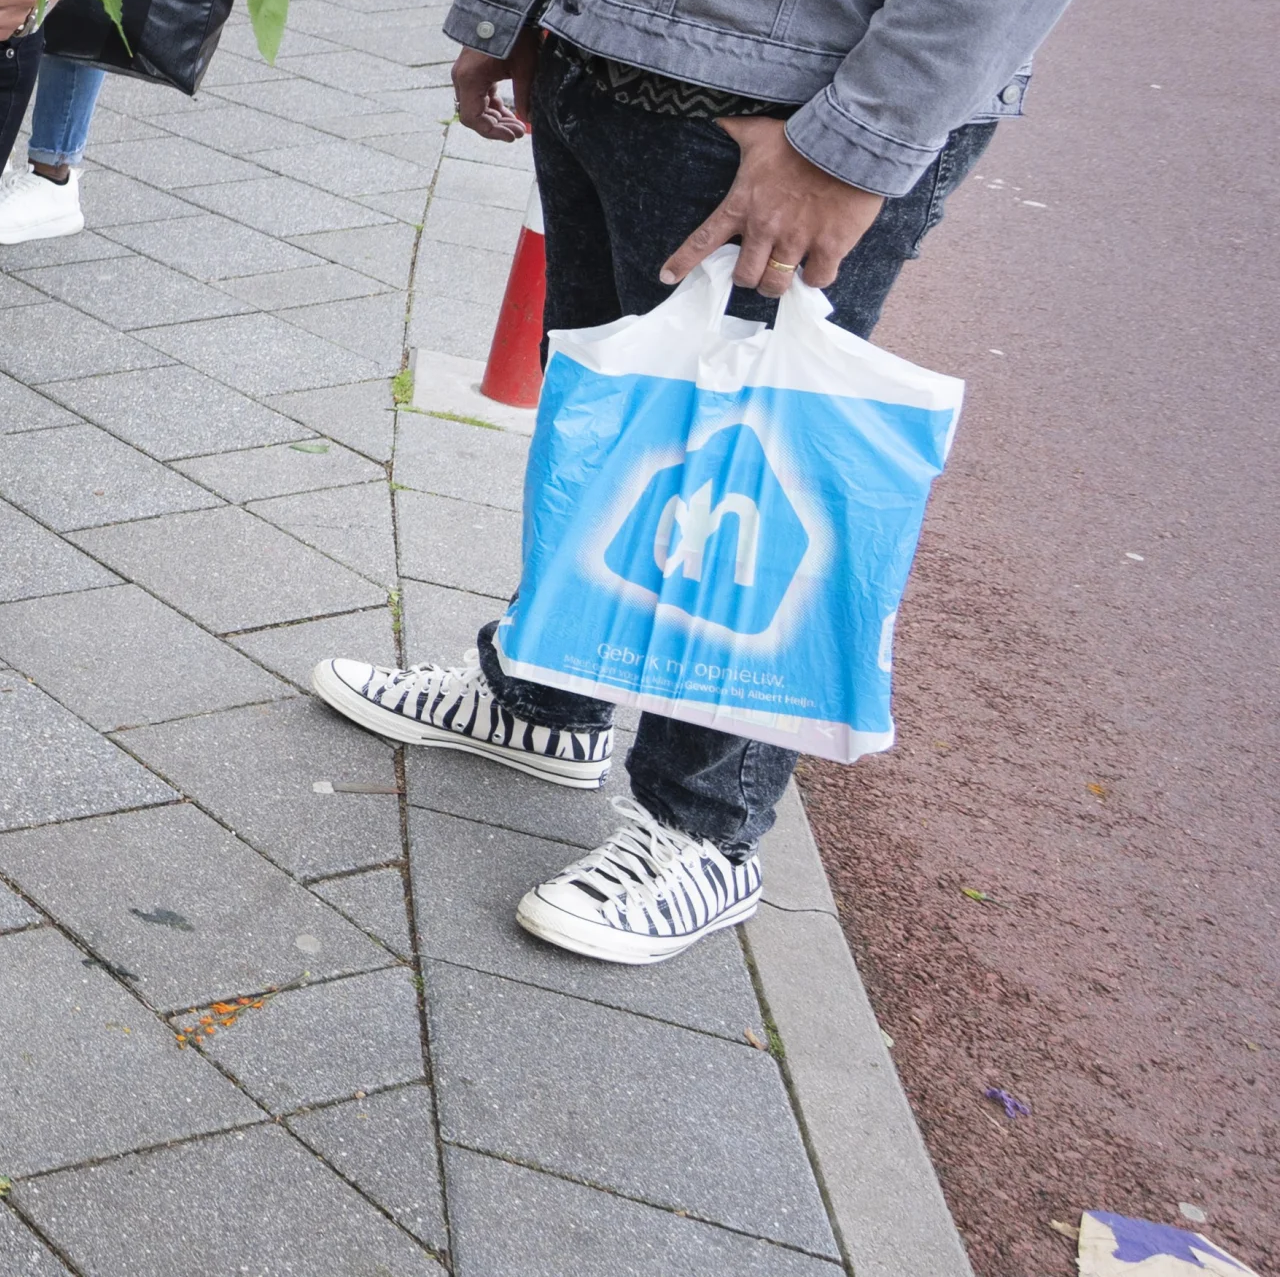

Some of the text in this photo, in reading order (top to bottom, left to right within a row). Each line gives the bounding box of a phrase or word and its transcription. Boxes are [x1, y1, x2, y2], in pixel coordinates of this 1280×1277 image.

[597, 642, 659, 670] Gebrk
[694, 662, 785, 689] opnieuw.
[731, 684, 746, 700] bij
[748, 686, 783, 704] Albert
